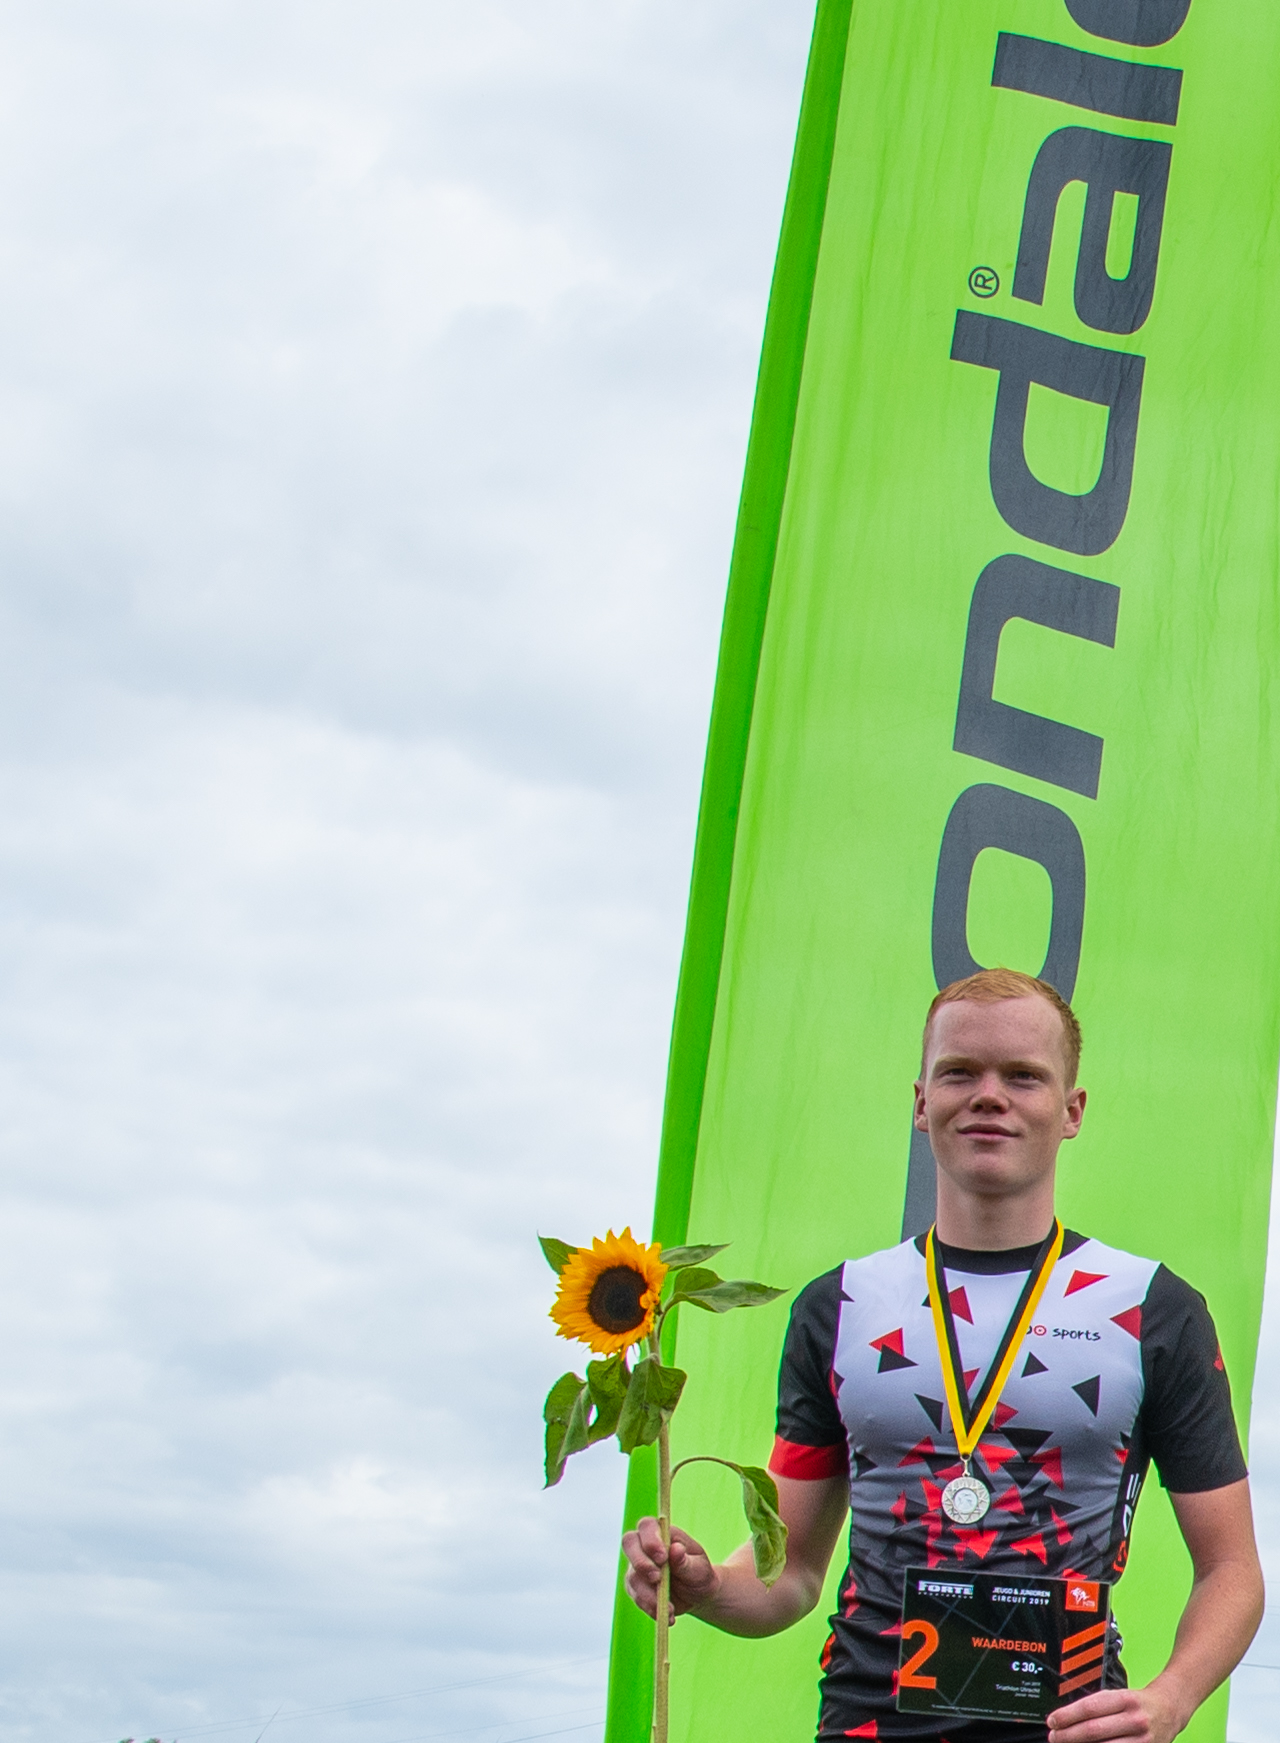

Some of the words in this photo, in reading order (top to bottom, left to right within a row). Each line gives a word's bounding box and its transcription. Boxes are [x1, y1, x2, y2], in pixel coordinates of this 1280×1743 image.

[900, 0, 1191, 1243] ondal
[1052, 1327, 1101, 1341] sports
[991, 1594, 1026, 1603] CIRCUIT
[1029, 1597, 1050, 1605] 2019
[971, 1636, 1047, 1654] WAARDEBON
[899, 1619, 939, 1689] 2
[1011, 1660, 1020, 1672] €
[1021, 1662, 1044, 1675] 30,-
